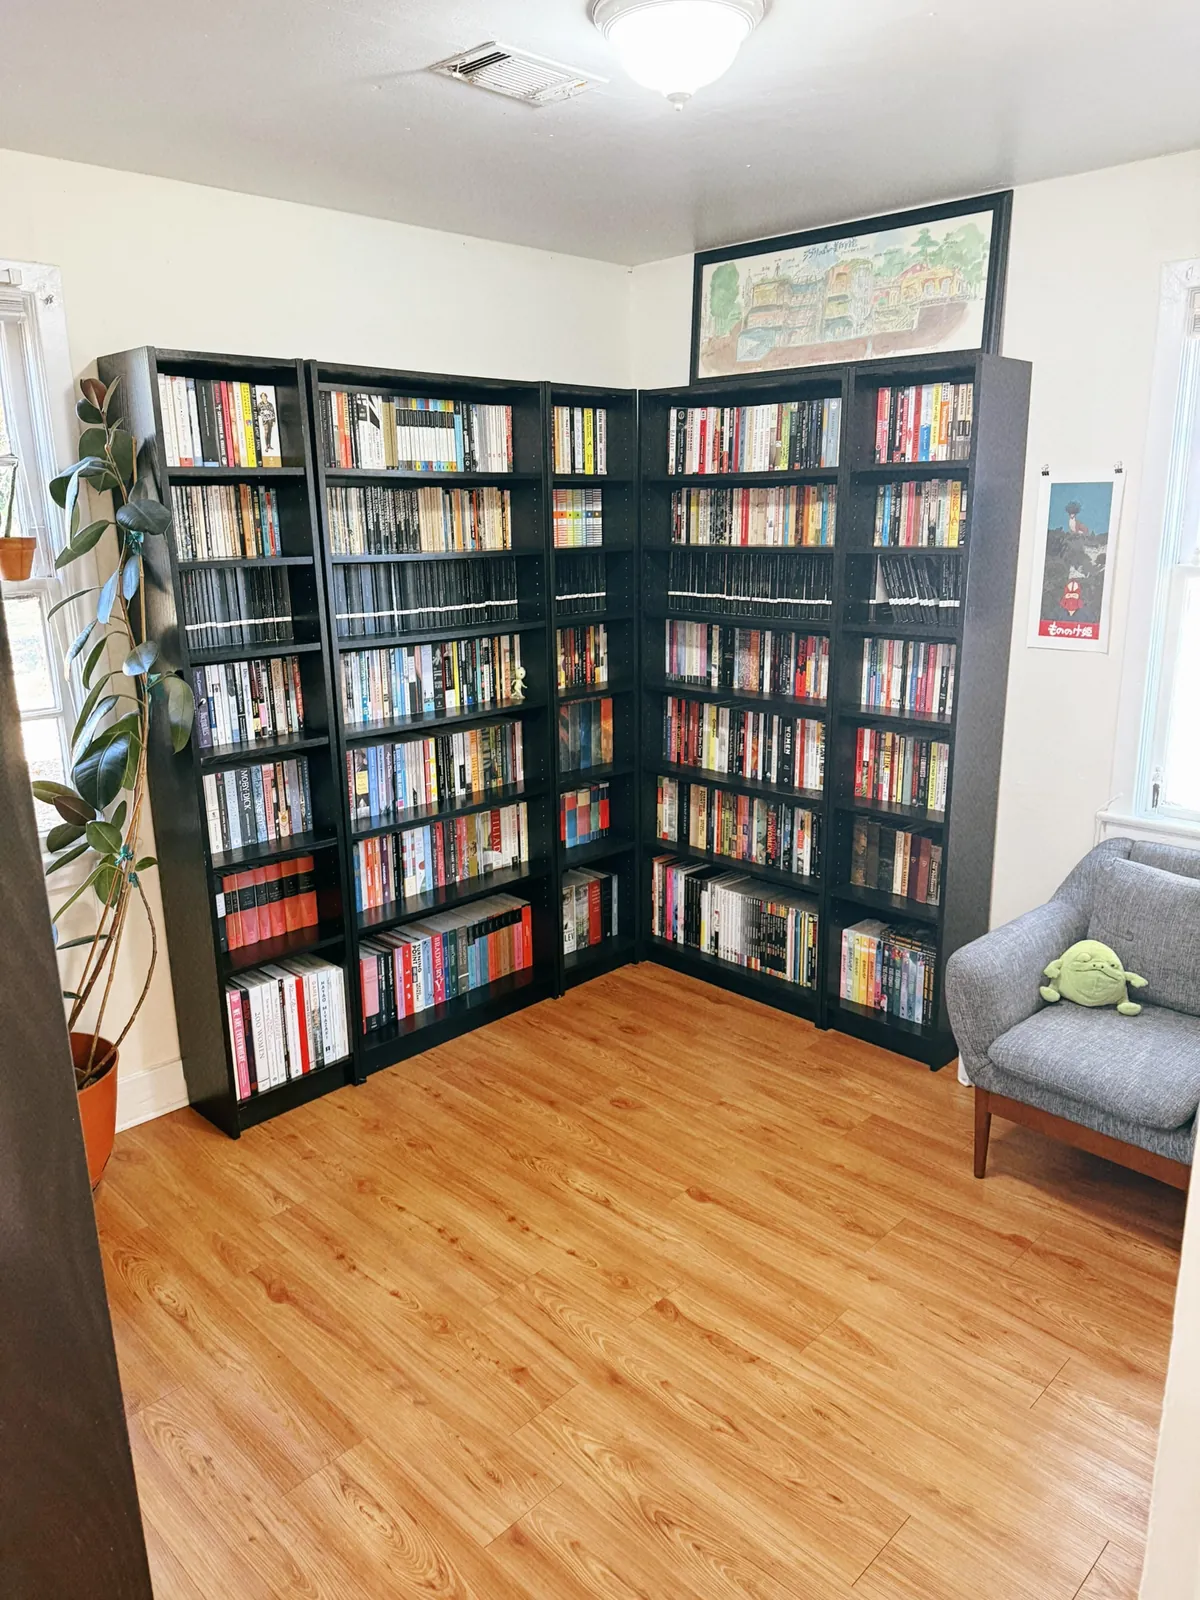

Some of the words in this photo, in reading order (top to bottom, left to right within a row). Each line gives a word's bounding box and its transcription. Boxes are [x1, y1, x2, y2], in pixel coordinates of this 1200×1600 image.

[1048, 621, 1093, 637] もののけ姫
[434, 937, 443, 978] BRADBURY
[233, 1008, 241, 1017] WE
[235, 1029, 246, 1063] EVERYWHERE
[256, 1030, 265, 1060] WOMEN
